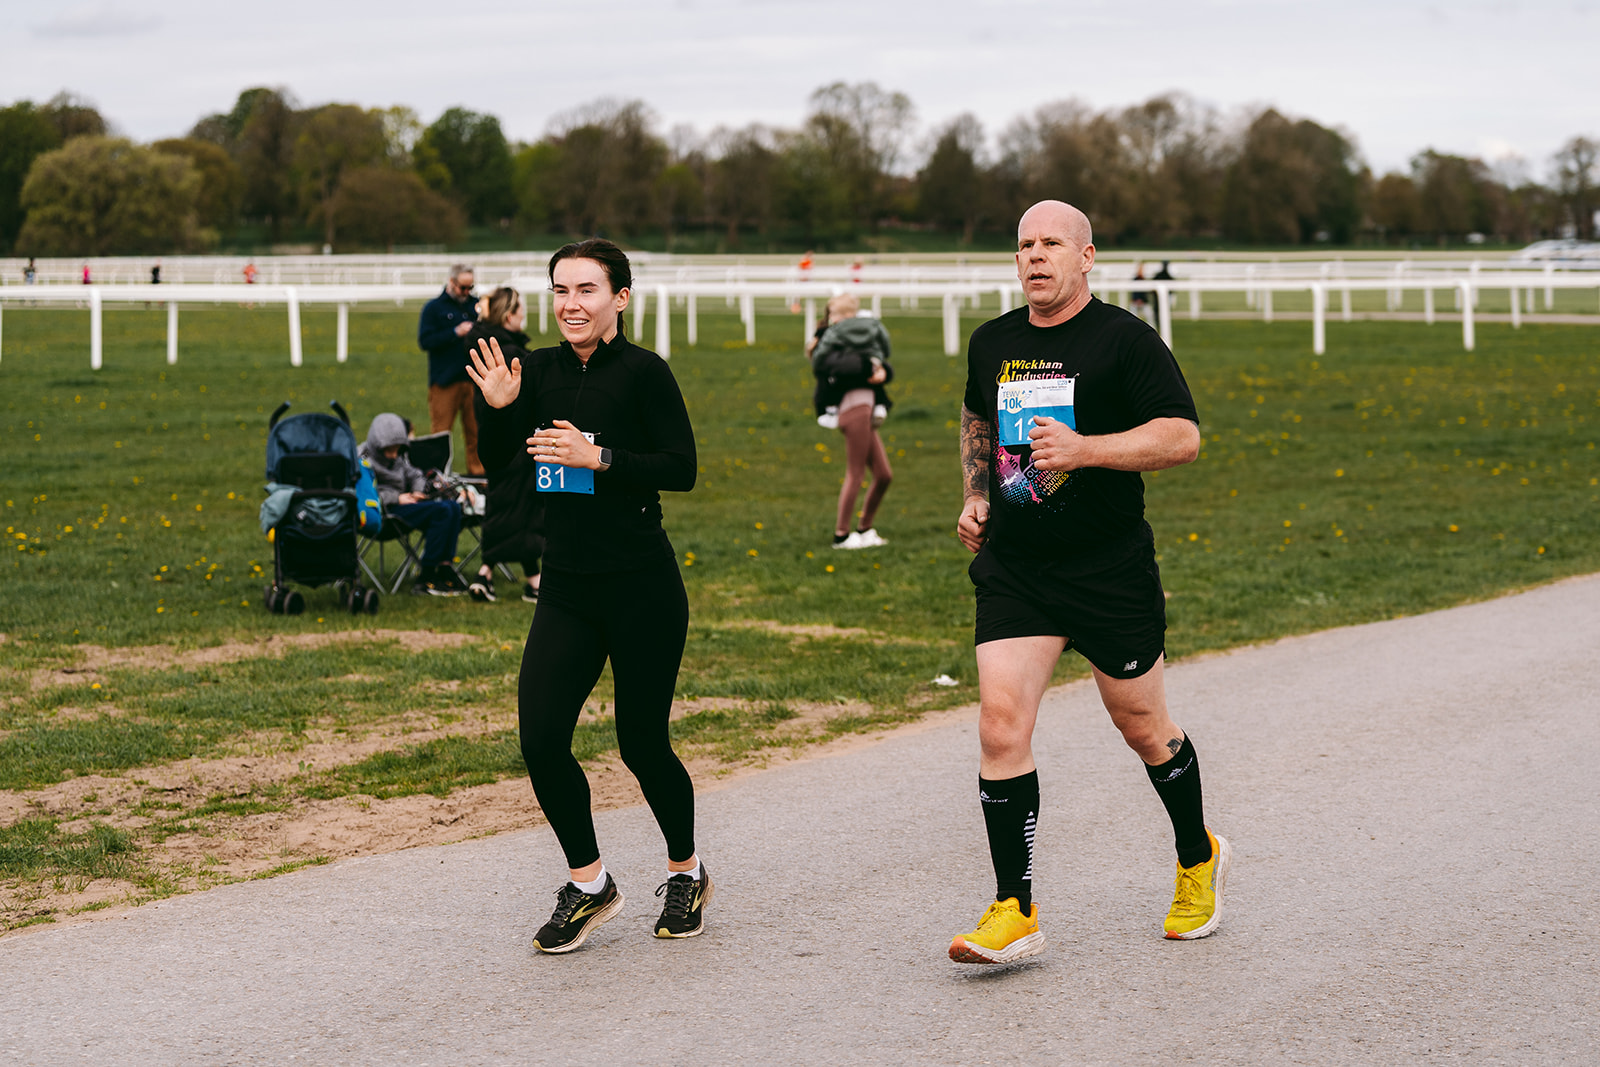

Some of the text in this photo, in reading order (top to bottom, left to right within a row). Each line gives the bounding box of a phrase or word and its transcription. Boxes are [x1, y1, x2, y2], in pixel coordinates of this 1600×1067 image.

[1011, 359, 1063, 370] Wickham
[1011, 371, 1067, 381] Industries
[1002, 397, 1022, 410] 10k
[538, 466, 565, 489] 81
[1045, 470, 1066, 489] OUTDO
[1048, 473, 1069, 494] FITNESS
